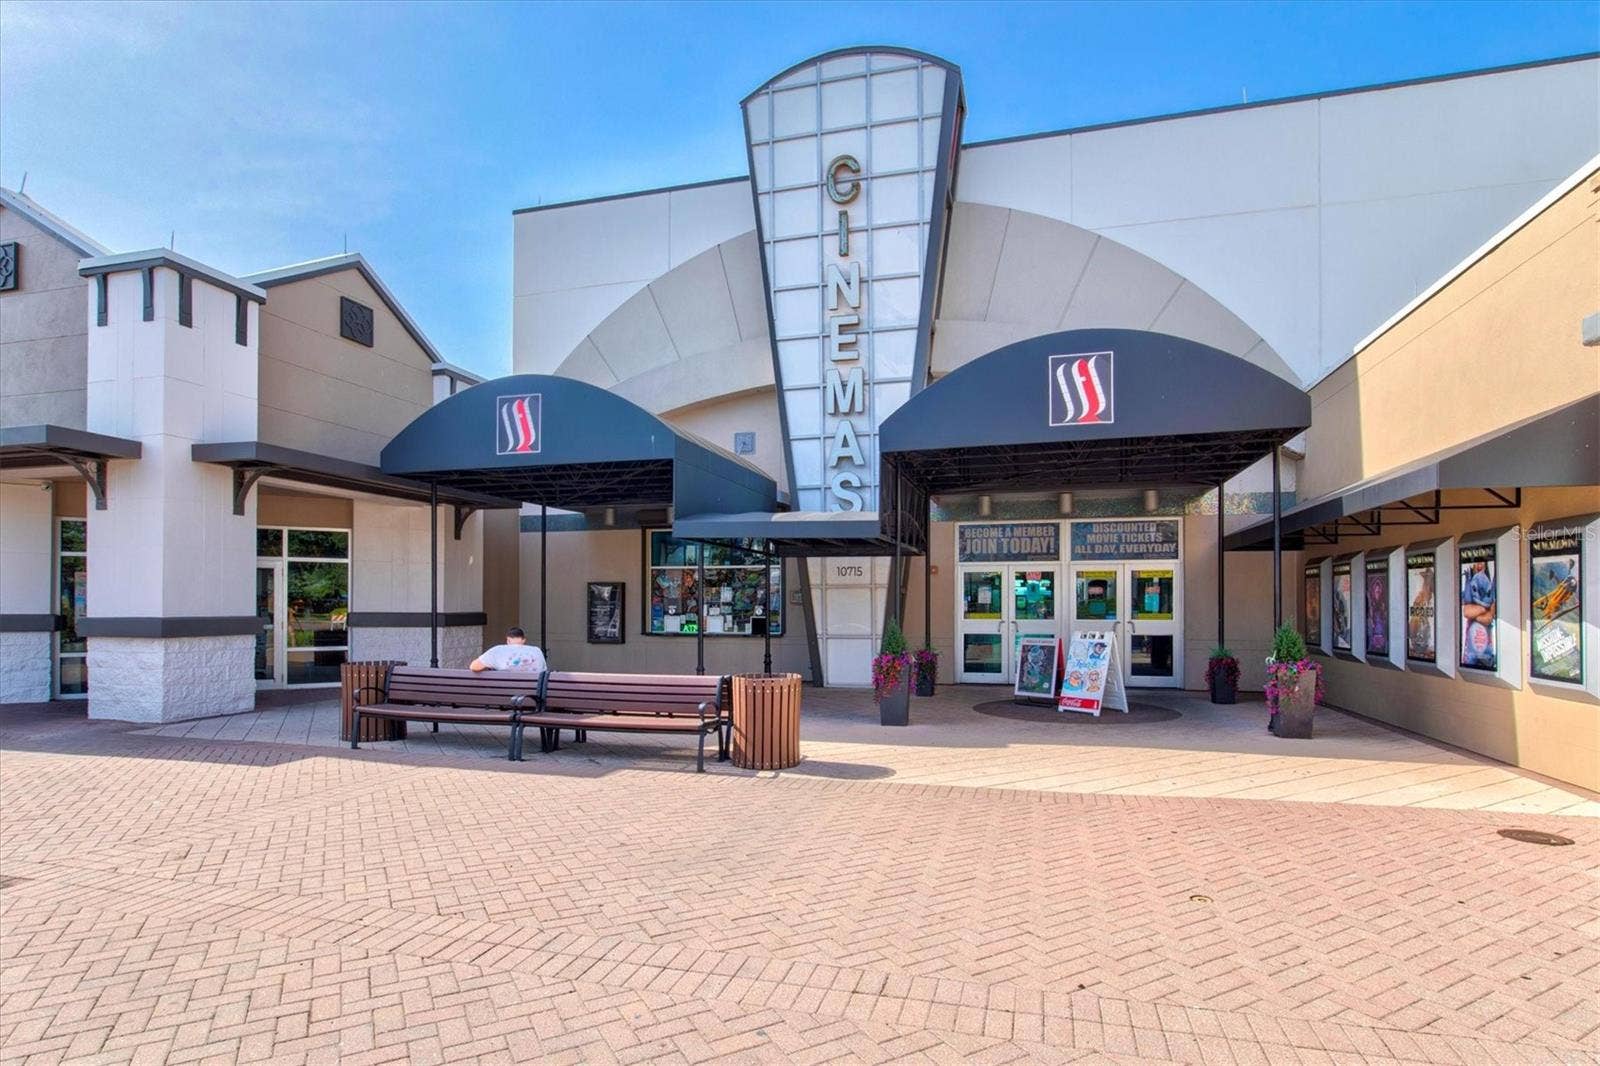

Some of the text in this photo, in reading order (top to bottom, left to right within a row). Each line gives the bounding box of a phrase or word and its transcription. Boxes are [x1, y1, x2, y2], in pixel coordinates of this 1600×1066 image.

[826, 154, 865, 512] CINEMAS
[964, 526, 1055, 538] BECOME A MEMBER
[1093, 522, 1157, 532] DISCOUNTED
[1087, 532, 1163, 543] MOVIE TICKETS
[964, 536, 1055, 554] JOIN TODAY!
[1074, 544, 1093, 553] ALL
[1120, 543, 1177, 552] EVERYDAY
[836, 566, 864, 577] 10715
